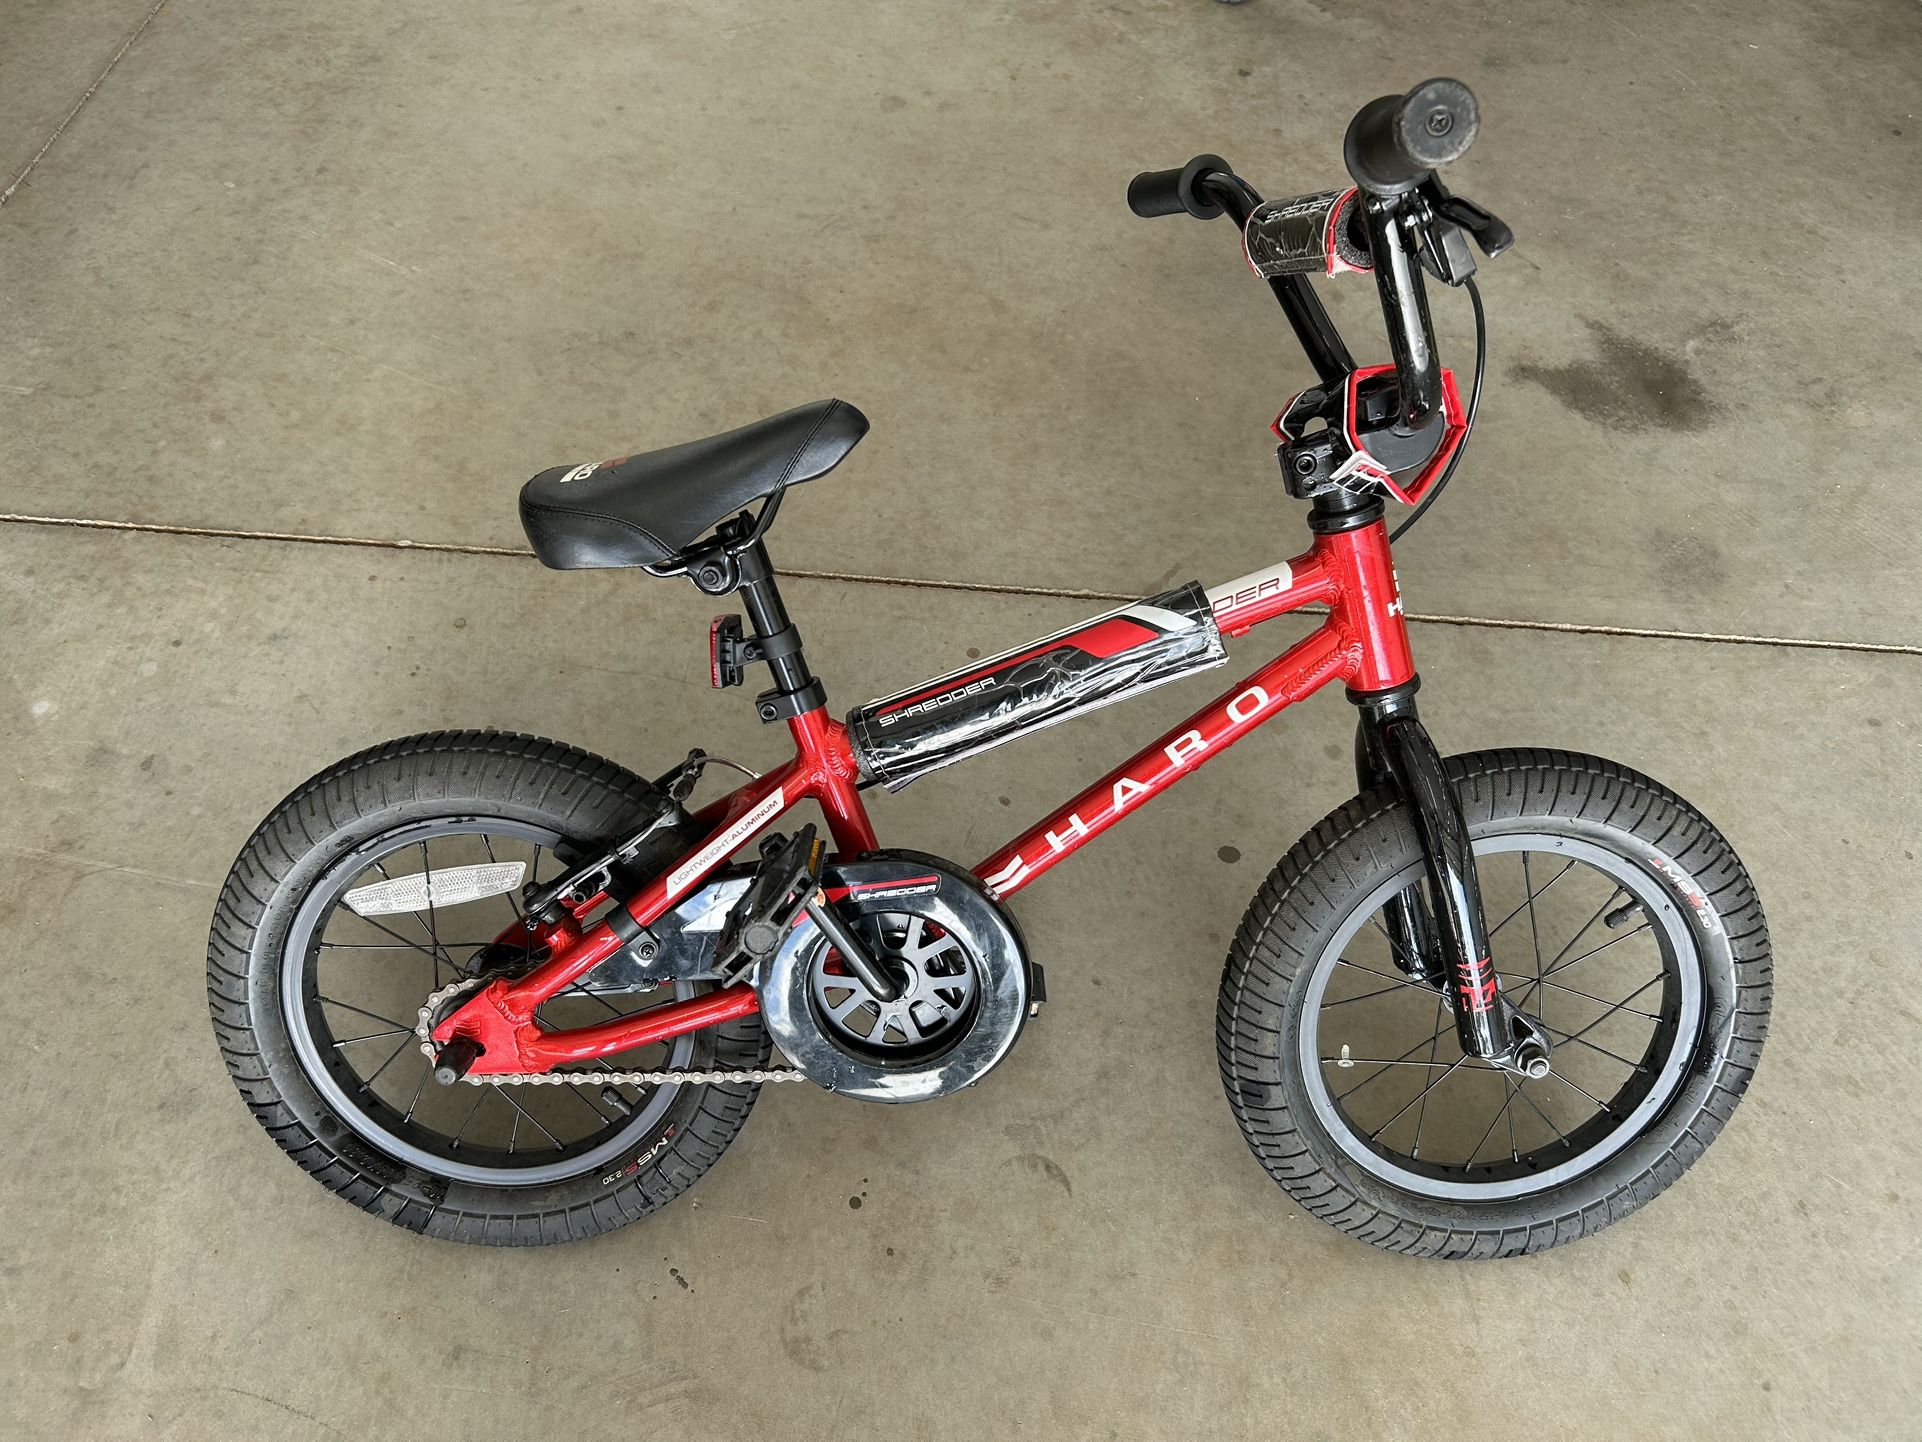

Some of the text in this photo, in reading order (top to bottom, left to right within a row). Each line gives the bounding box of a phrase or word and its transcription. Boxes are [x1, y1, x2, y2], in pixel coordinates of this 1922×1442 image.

[879, 677, 996, 727] SHREDDER
[1044, 685, 1269, 853] HARO
[857, 884, 937, 901] SHREDDER
